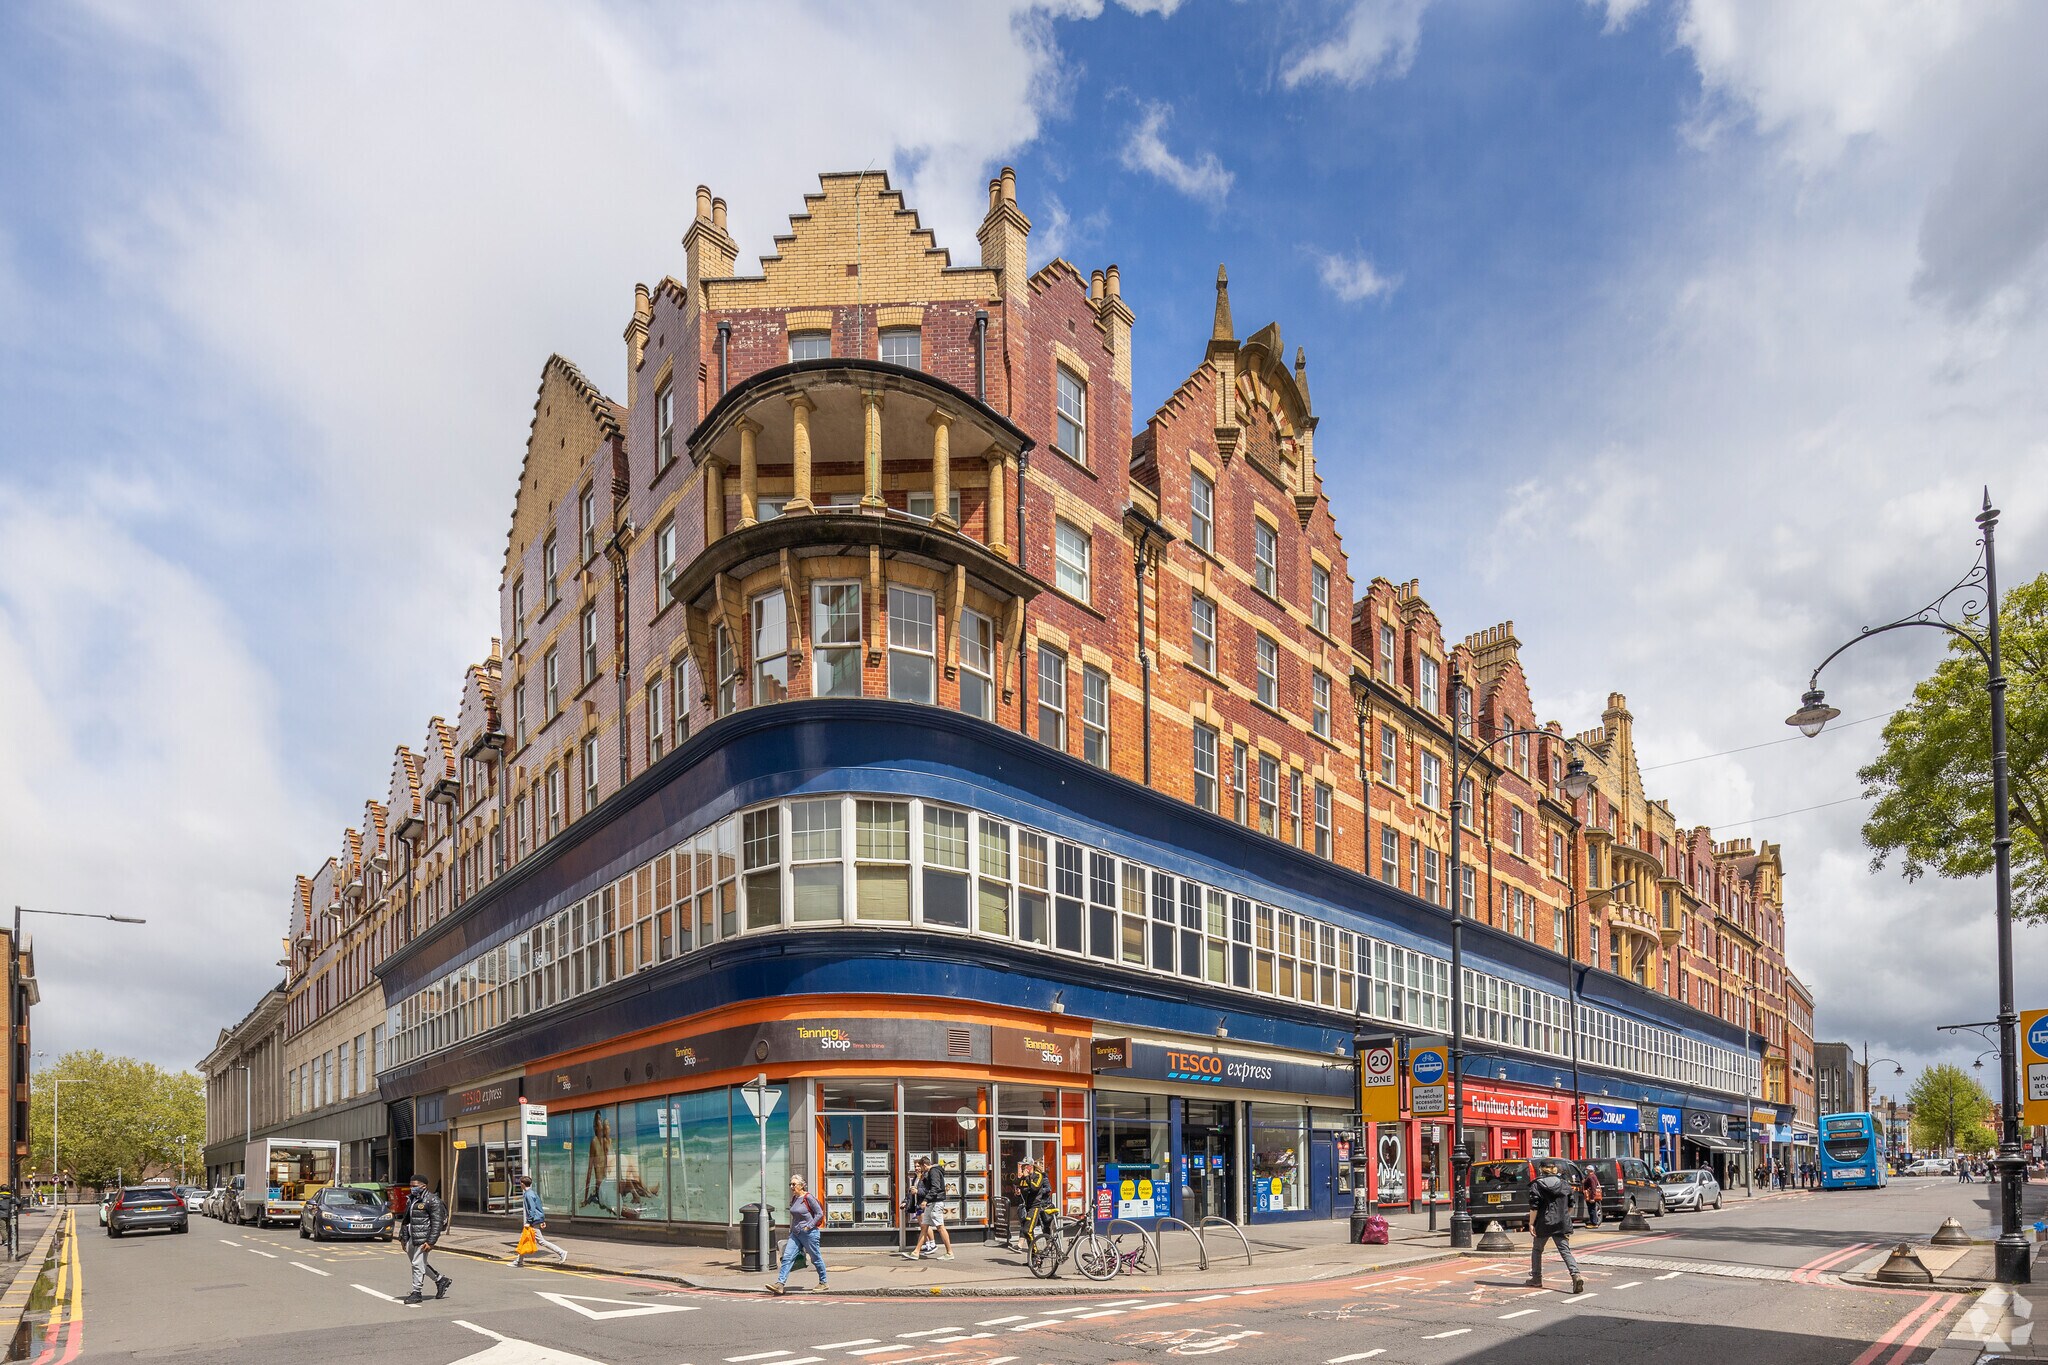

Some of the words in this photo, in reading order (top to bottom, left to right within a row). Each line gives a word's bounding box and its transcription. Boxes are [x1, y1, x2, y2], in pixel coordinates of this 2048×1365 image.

[797, 1026, 839, 1040] Tanning
[821, 1037, 851, 1051] Shop
[1023, 1037, 1056, 1054] Tanning
[1095, 1046, 1118, 1055] Tanning
[674, 1046, 692, 1057] Tanning
[1041, 1050, 1063, 1066] Shop
[1107, 1052, 1123, 1061] Shop
[684, 1055, 697, 1067] Shop
[1167, 1051, 1223, 1075] TESCO
[1227, 1061, 1272, 1082] express
[1371, 1054, 1389, 1067] 20
[1368, 1075, 1392, 1084] ZONE
[1471, 1095, 1509, 1115] Furniture
[1509, 1099, 1516, 1116] &
[1517, 1100, 1549, 1119] Electrical
[1603, 1112, 1622, 1125] CORAL
